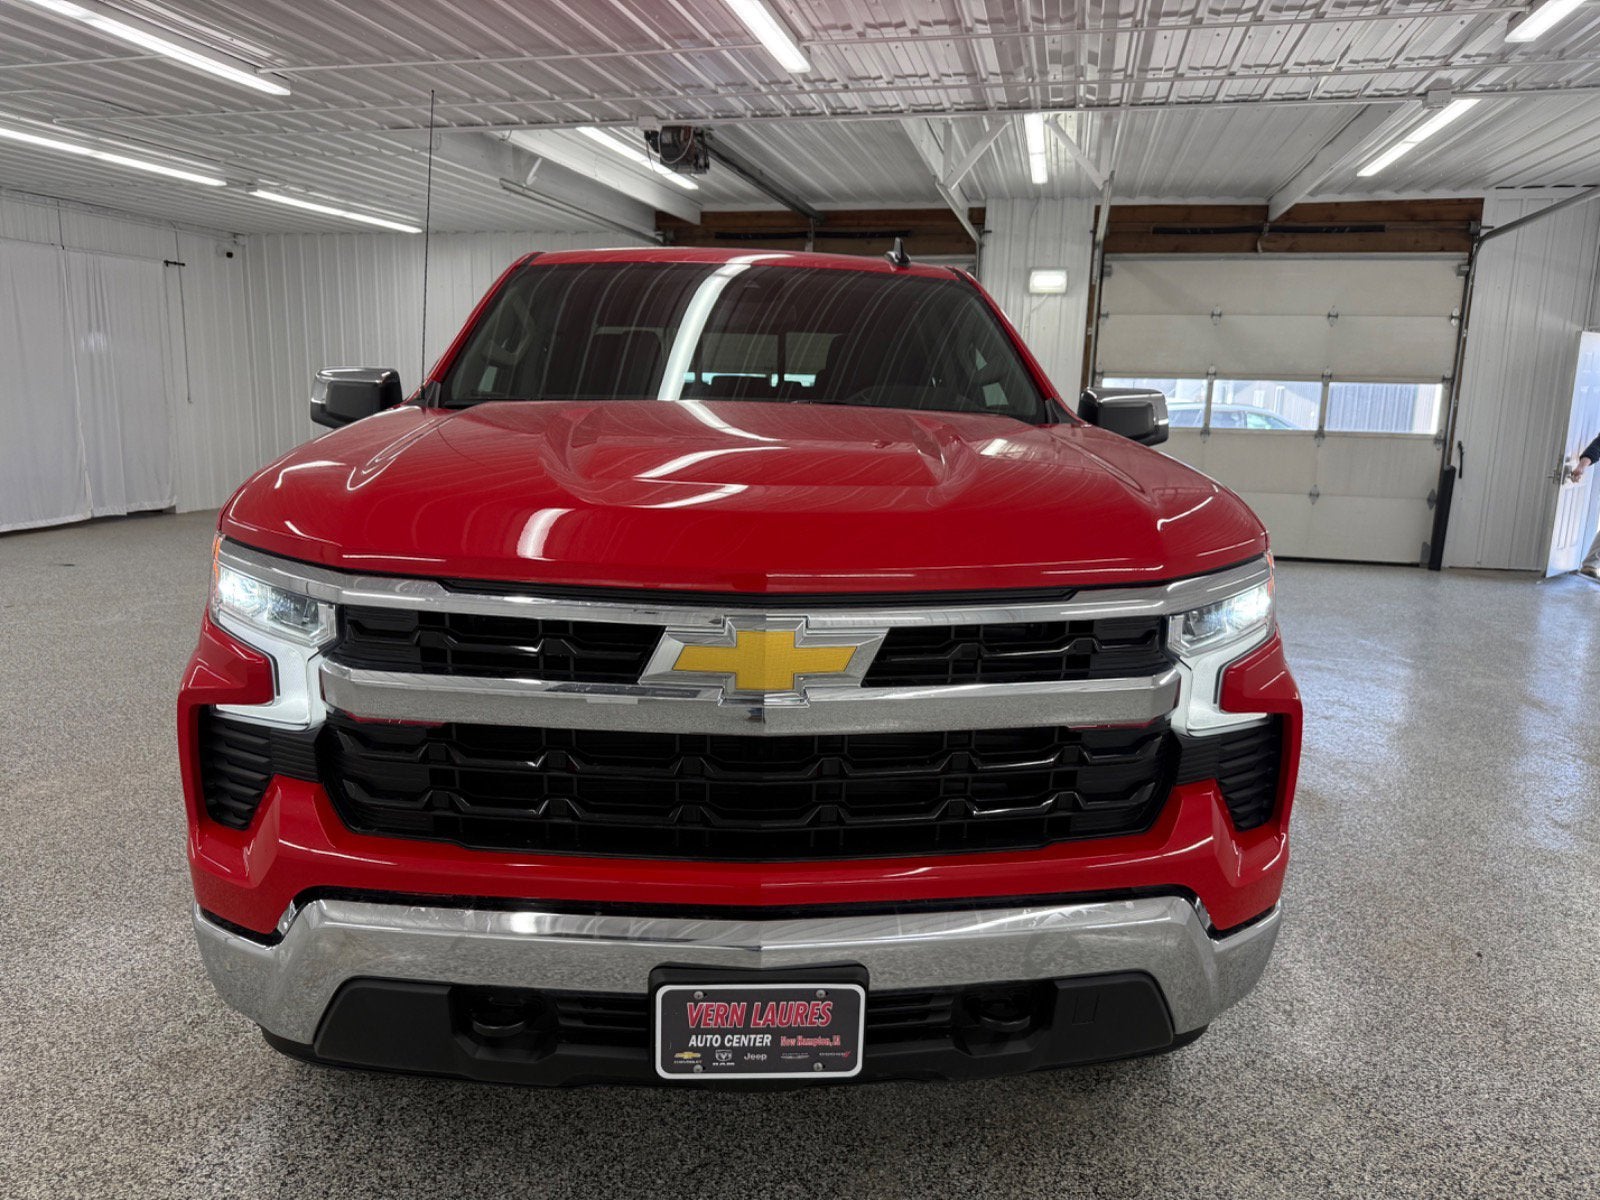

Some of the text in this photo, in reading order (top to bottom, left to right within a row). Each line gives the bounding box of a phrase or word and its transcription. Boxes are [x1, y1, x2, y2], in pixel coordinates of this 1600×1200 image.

[687, 1001, 833, 1028] VERN LAURES
[688, 1034, 772, 1047] AUTO CENTER
[780, 1036, 796, 1047] New
[744, 1053, 767, 1061] Jeep
